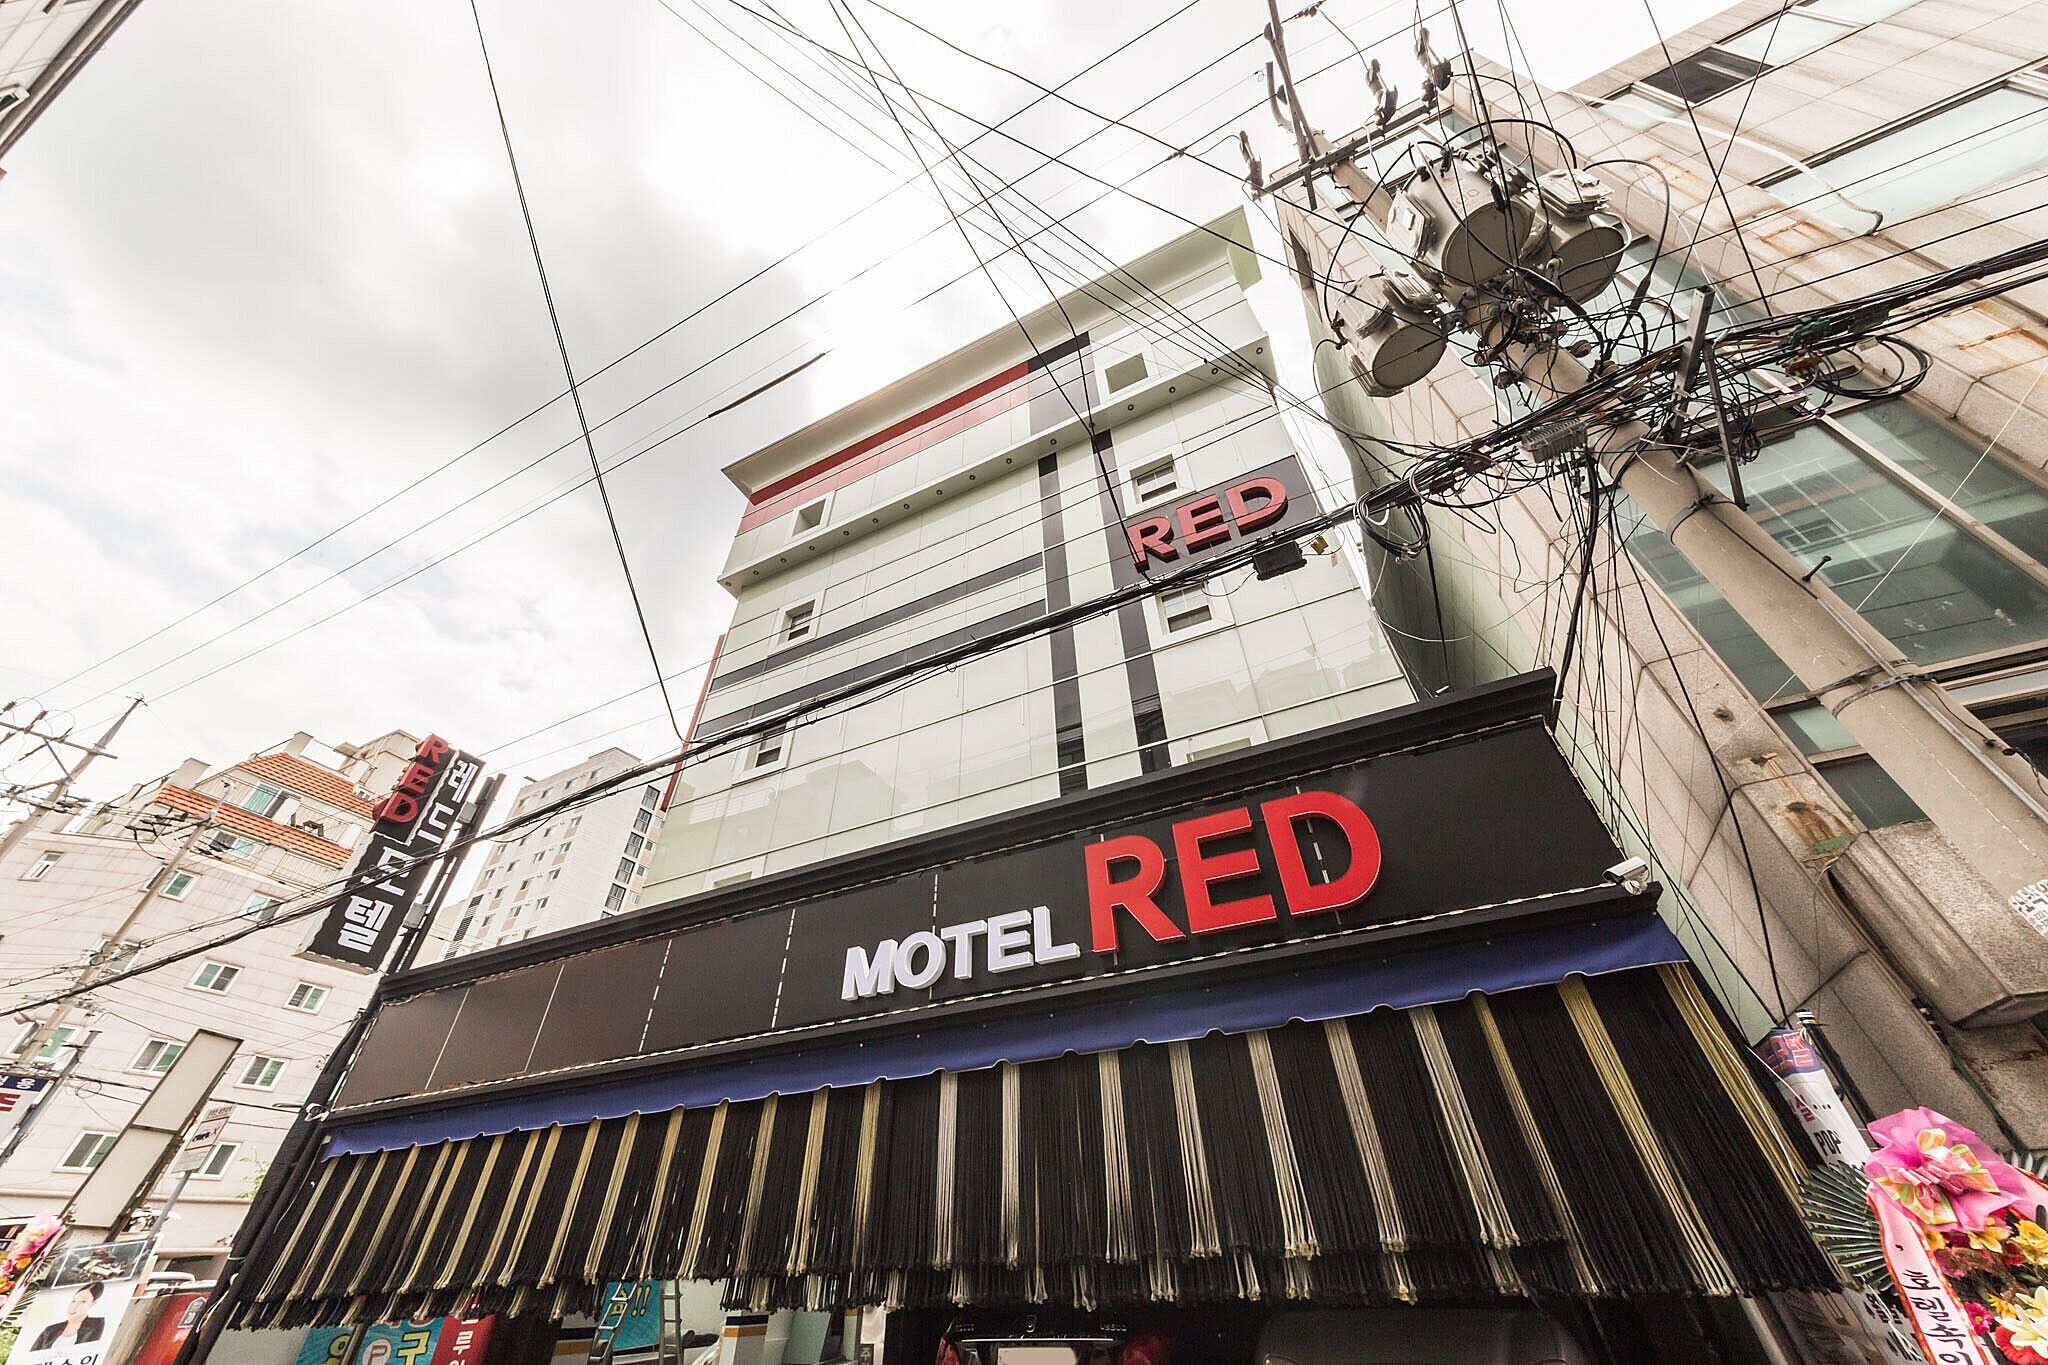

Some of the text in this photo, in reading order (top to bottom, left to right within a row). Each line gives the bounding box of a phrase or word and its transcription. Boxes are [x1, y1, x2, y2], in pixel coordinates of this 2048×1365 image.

[1127, 477, 1289, 572] RED
[376, 734, 449, 823] RED
[338, 759, 479, 953] 레드모텔
[841, 790, 1381, 1001] MOTEL RED
